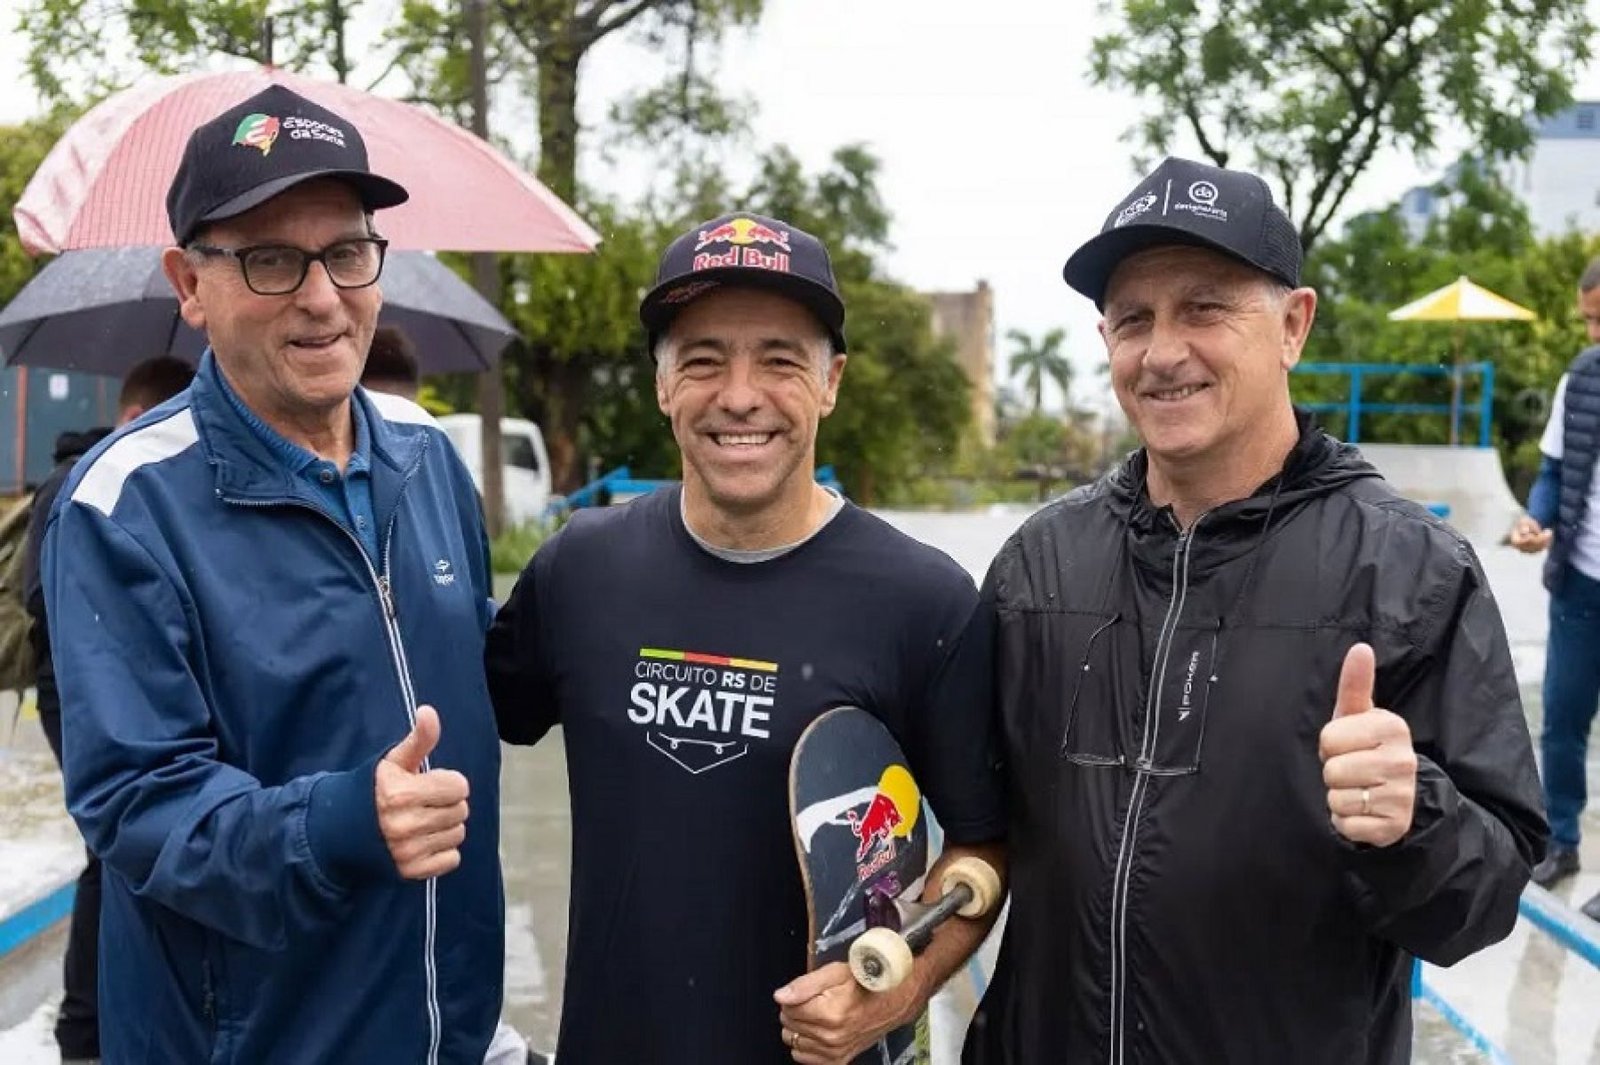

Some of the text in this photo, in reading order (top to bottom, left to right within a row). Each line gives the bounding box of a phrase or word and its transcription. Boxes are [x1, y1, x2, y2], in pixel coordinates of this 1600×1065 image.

[693, 246, 789, 272] Red Bull
[634, 660, 778, 693] CIRCUITO RS DE
[626, 681, 775, 739] SKATE
